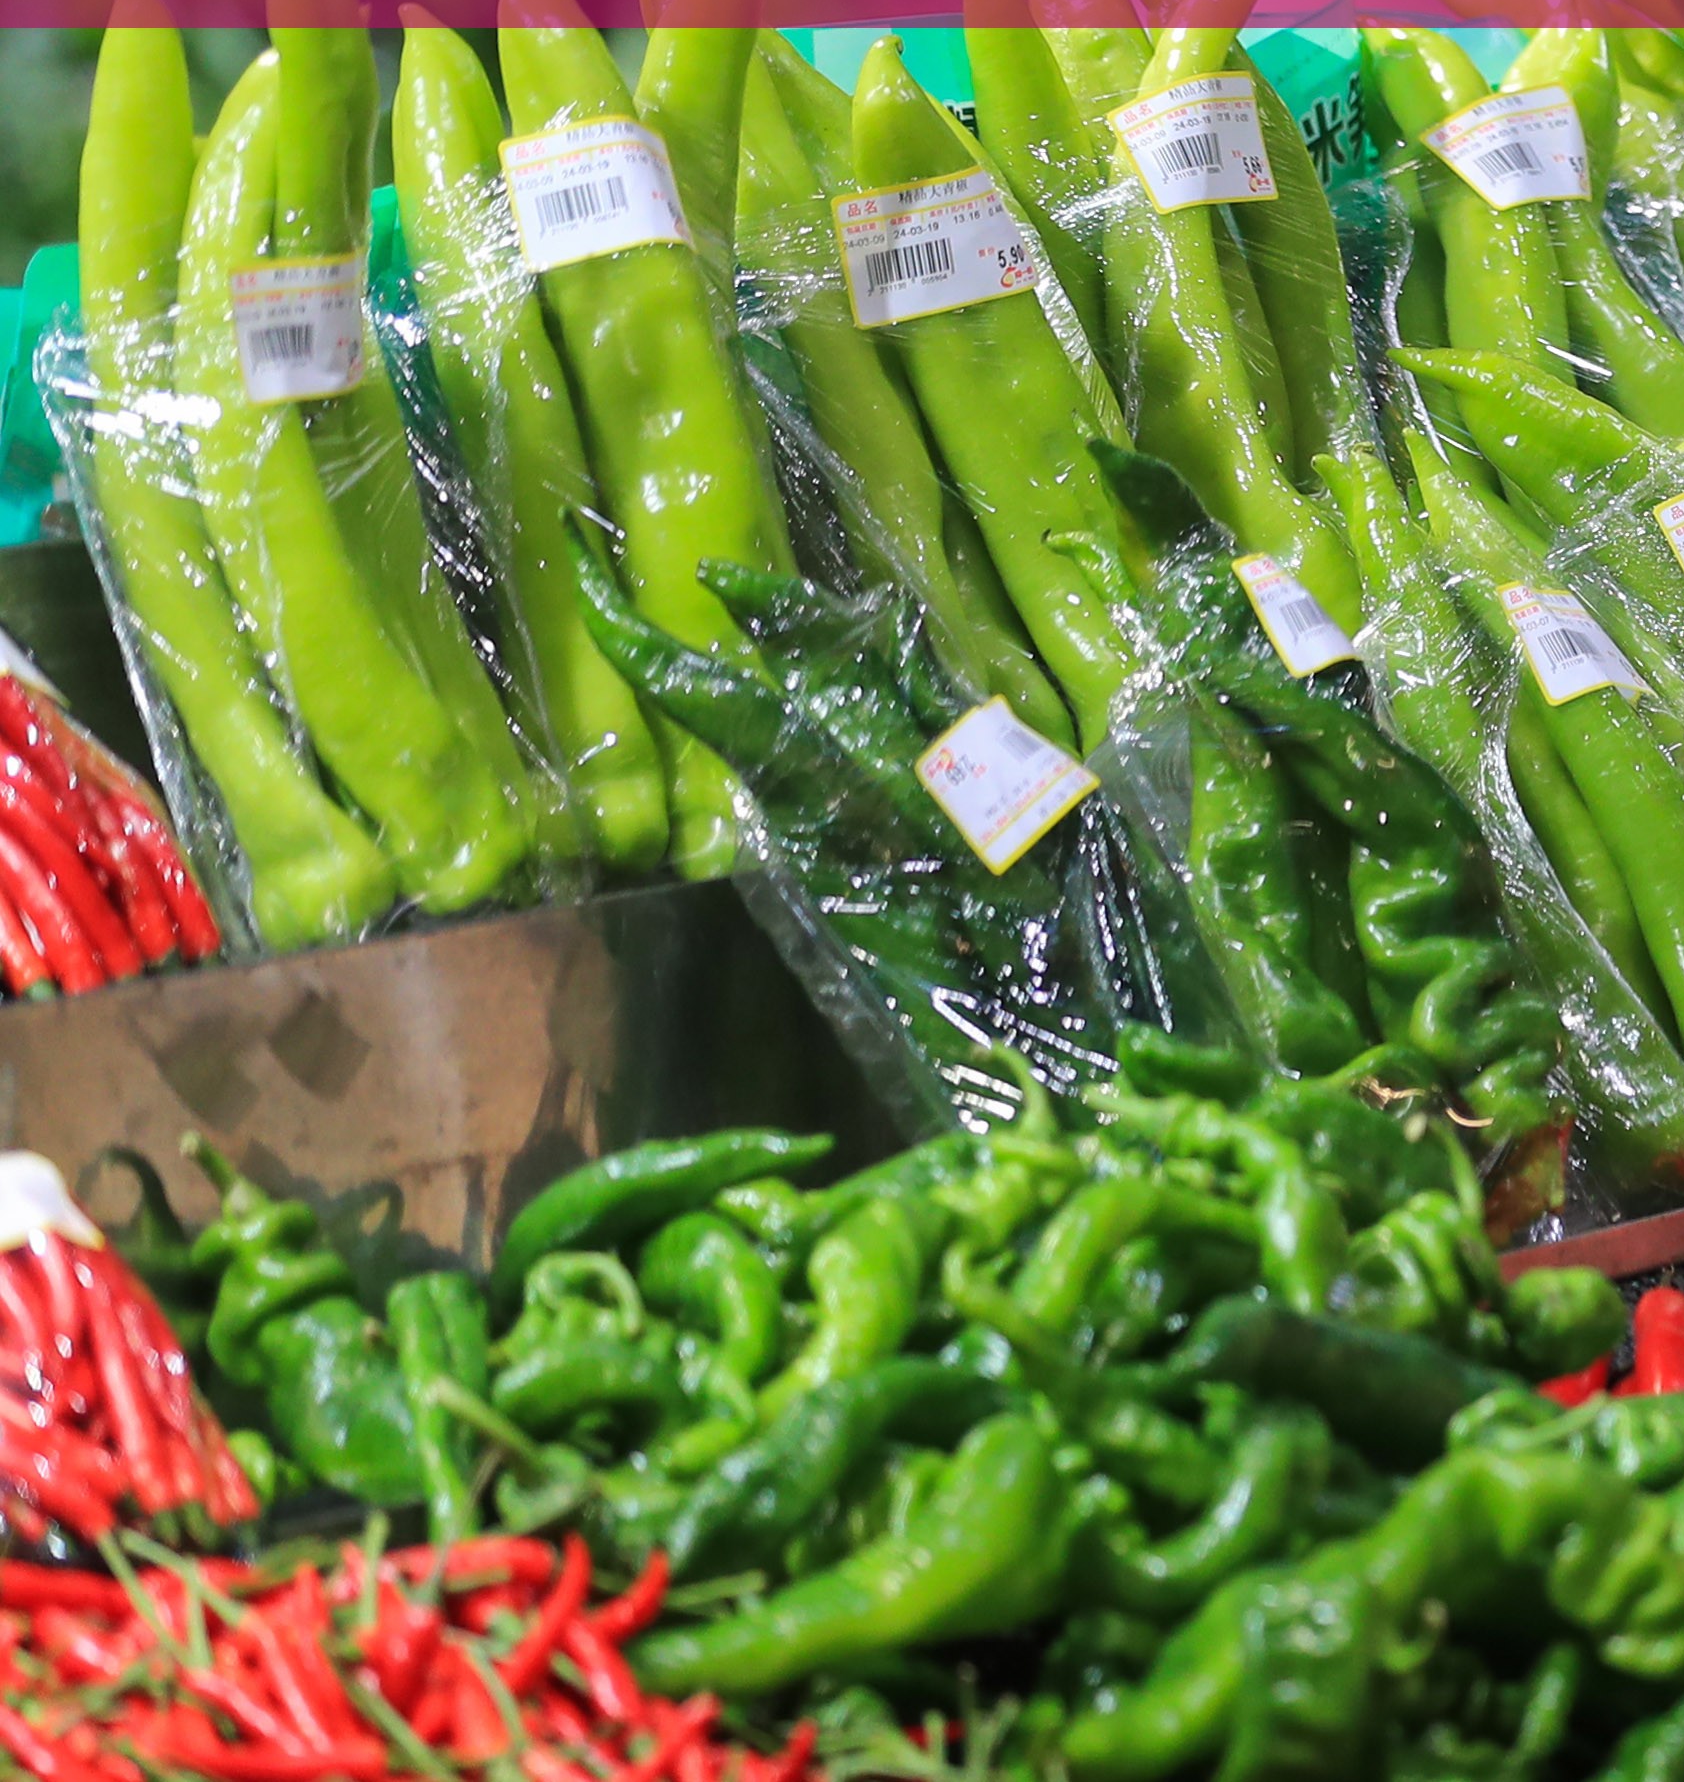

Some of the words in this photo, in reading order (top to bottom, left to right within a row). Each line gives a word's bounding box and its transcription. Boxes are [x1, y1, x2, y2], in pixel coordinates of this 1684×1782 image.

[1123, 103, 1153, 125] 品名
[847, 200, 879, 218] 品名
[898, 178, 969, 206] 精品大青椒
[893, 221, 940, 240] 24-03-19
[997, 243, 1026, 269] 5.90
